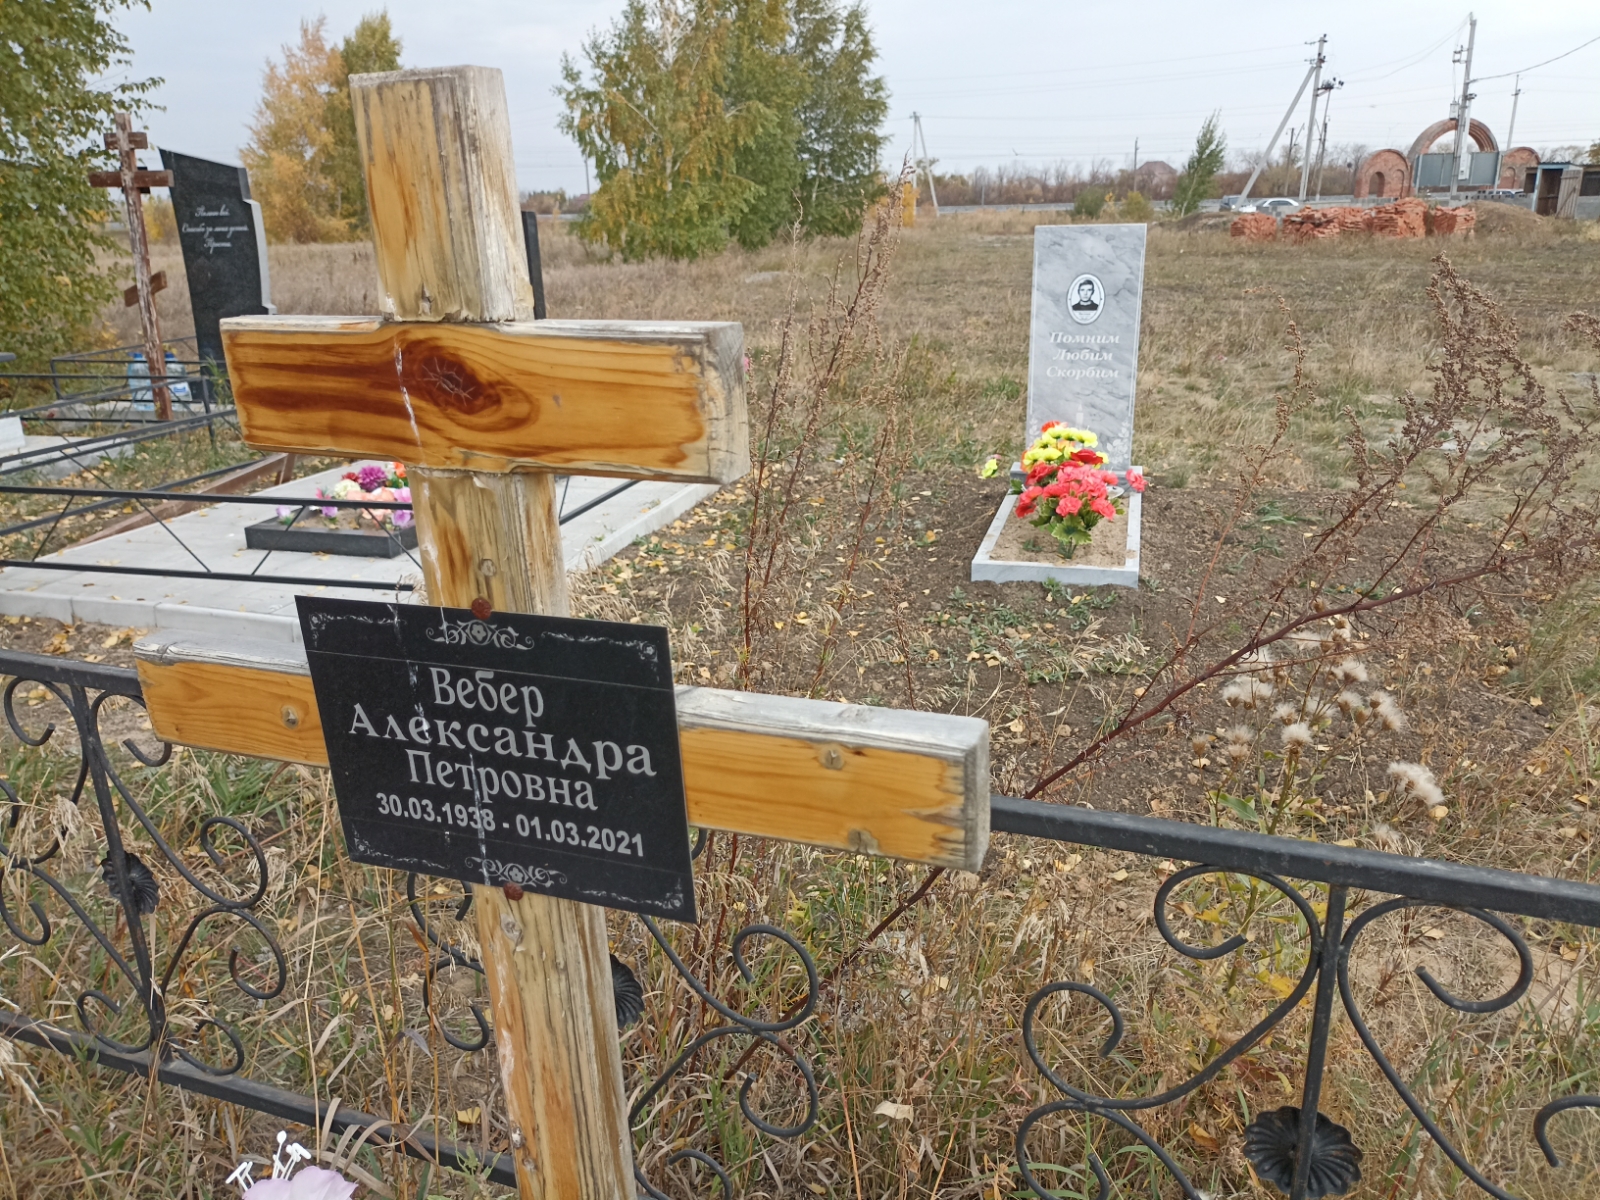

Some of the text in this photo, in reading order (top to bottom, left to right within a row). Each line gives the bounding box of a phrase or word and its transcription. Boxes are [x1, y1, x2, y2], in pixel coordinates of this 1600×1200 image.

[1049, 331, 1120, 344] Помним
[1052, 349, 1113, 361] Любим
[1046, 365, 1119, 380] Скорбим
[429, 666, 545, 728] Вебер
[348, 702, 657, 781] Александра
[405, 748, 599, 811] Петровна
[375, 792, 496, 831] 30.03.1938
[515, 813, 644, 857] 01.03.2021
